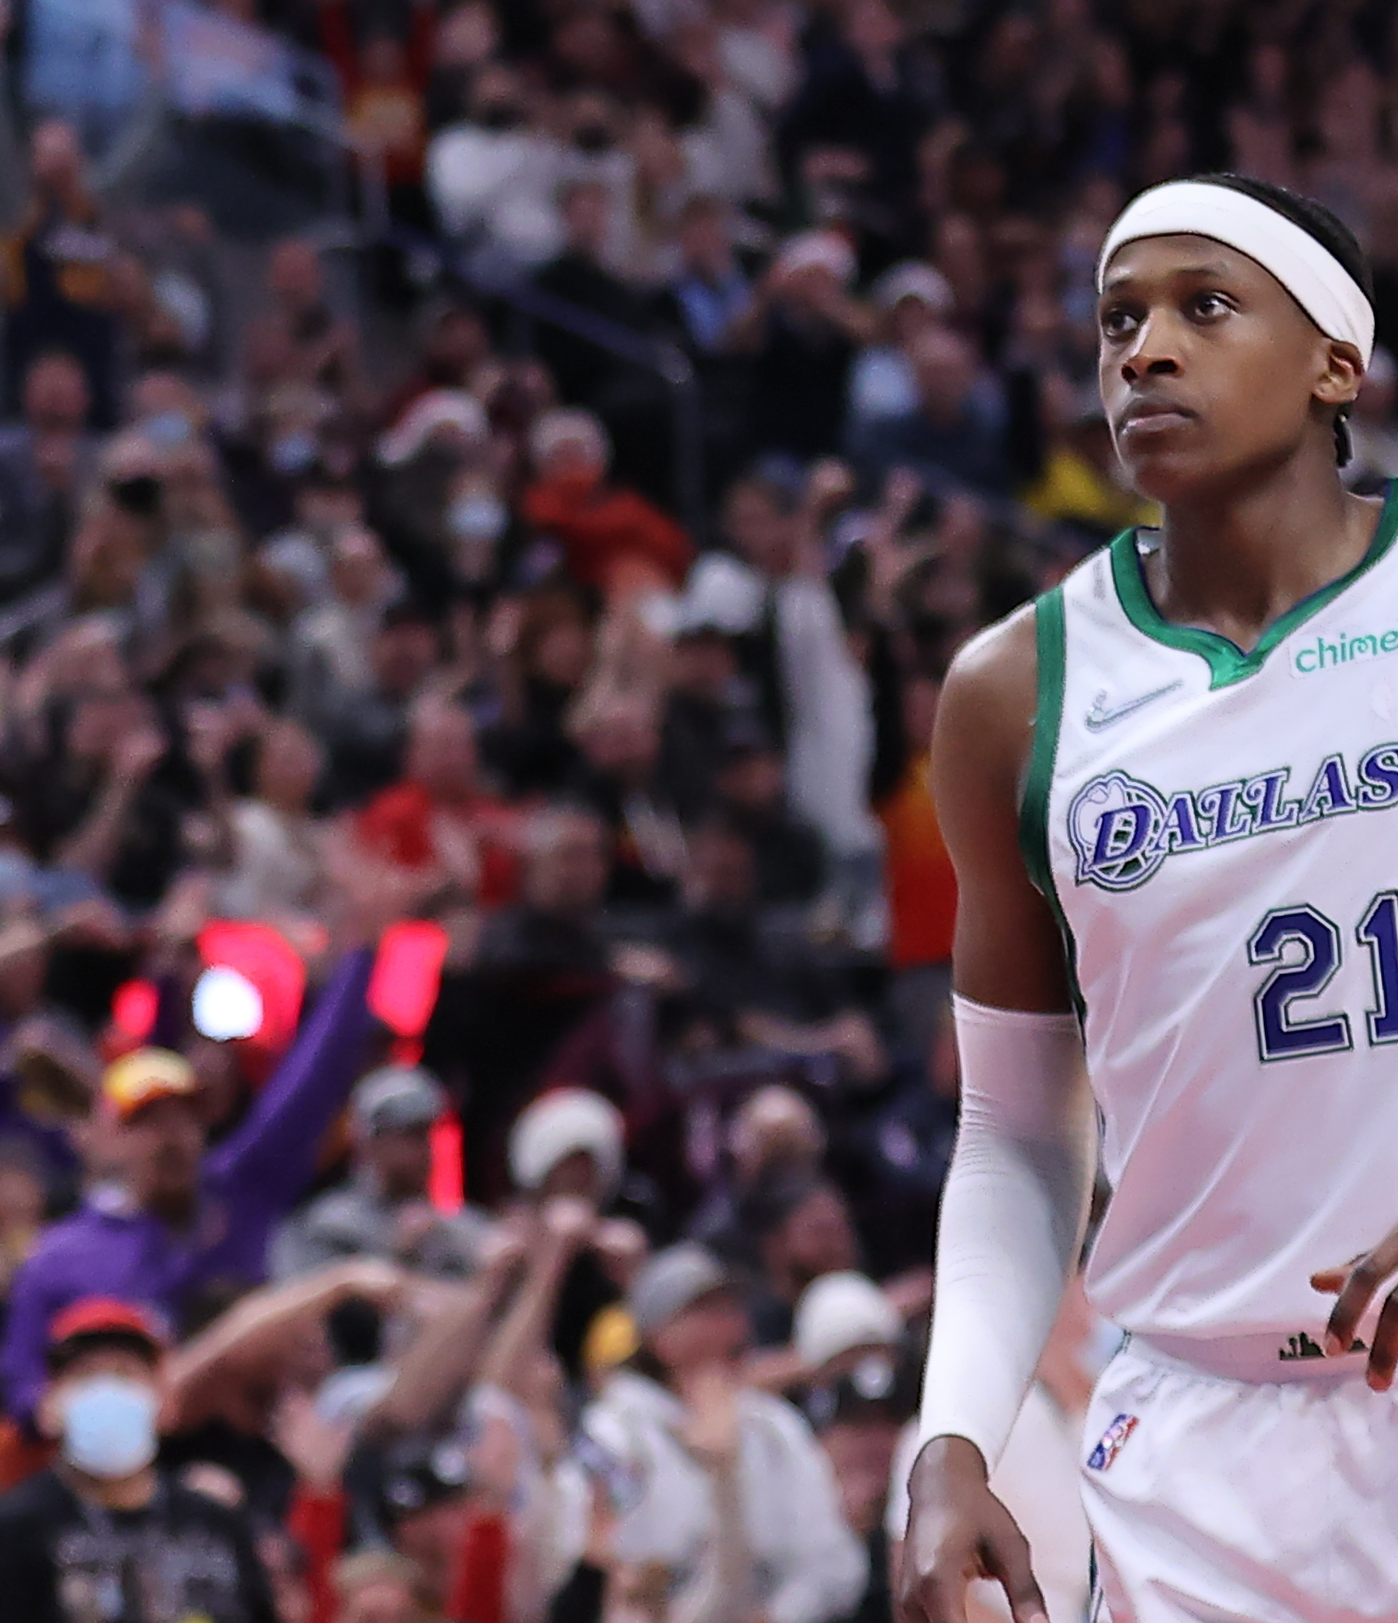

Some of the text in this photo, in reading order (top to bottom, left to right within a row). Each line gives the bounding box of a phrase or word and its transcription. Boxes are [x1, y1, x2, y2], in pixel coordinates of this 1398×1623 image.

[1295, 629, 1398, 673] chime
[1084, 741, 1398, 872] DALLAS
[1247, 889, 1398, 1063] 21
